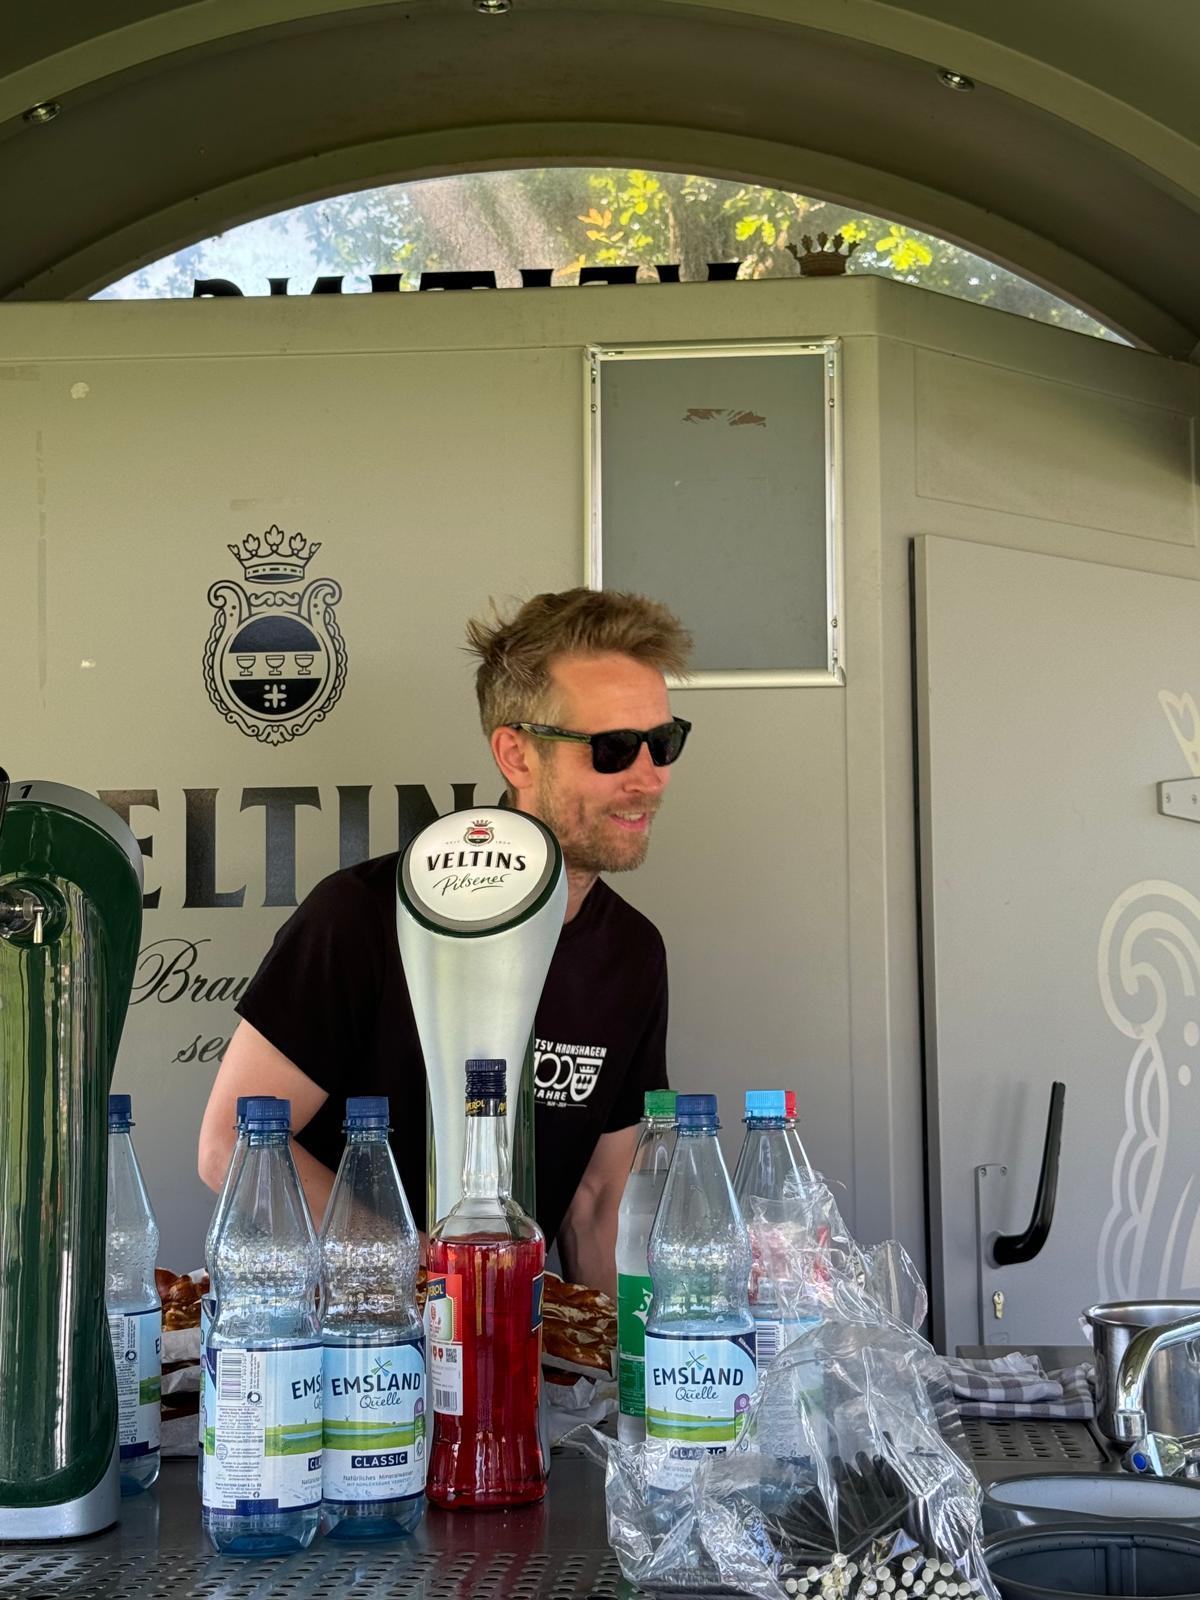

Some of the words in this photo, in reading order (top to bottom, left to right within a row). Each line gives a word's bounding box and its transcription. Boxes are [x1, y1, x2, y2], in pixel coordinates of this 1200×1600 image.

[20, 784, 33, 799] 1
[97, 783, 509, 909] ELTIN
[426, 850, 526, 872] VELTINS
[432, 873, 511, 896] Pilsener
[535, 1038, 554, 1052] TSV
[555, 1042, 607, 1058] KRONSHAGEN
[534, 1088, 568, 1101] AHRE
[331, 1372, 421, 1396] EMSLAND
[652, 1367, 744, 1386] EMSLAND
[354, 1453, 406, 1467] CLASSIC
